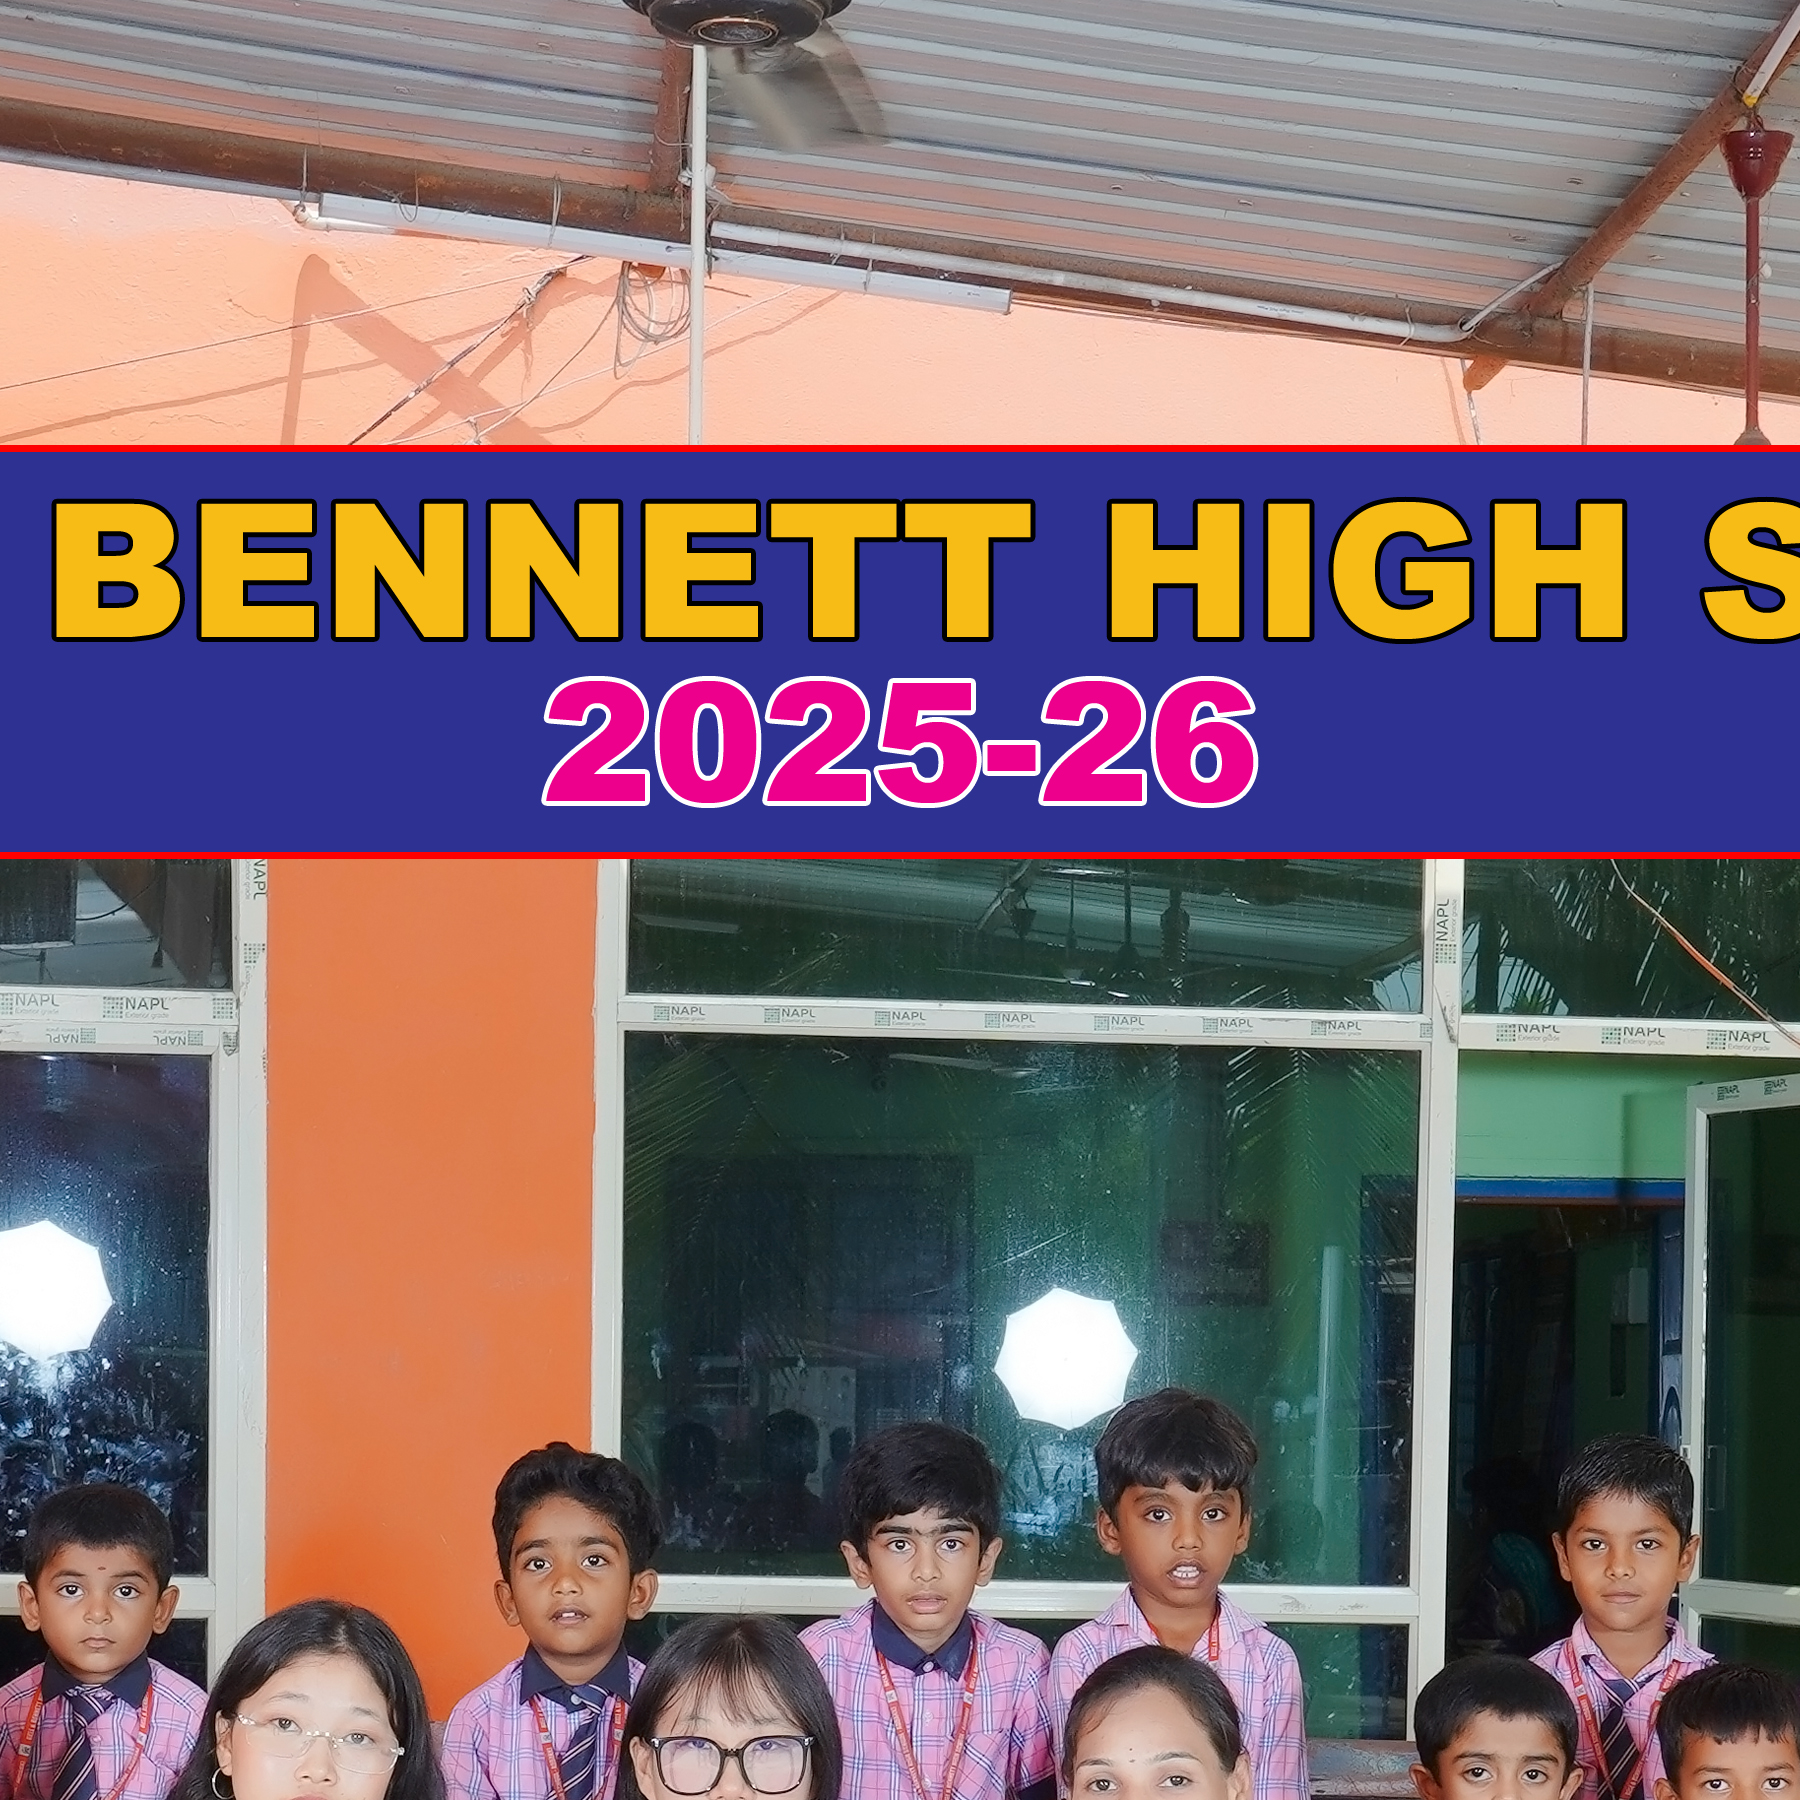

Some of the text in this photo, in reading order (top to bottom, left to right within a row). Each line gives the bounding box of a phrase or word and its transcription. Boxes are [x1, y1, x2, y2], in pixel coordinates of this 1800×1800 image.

[1437, 898, 1450, 941] NAPL
[15, 994, 60, 1006] NAPL
[125, 997, 169, 1010] NAPL
[671, 1006, 706, 1016] NAPL
[782, 1008, 816, 1018] NAPL
[892, 1011, 927, 1021] NAPL
[1002, 1013, 1036, 1023] NAPL
[1111, 1016, 1145, 1026] NAPL
[1220, 1018, 1254, 1029] NAPL
[1328, 1020, 1363, 1031] NAPL
[46, 1034, 79, 1044] NAPL
[153, 1035, 186, 1045] NAPL
[1728, 1030, 1771, 1044] NAPL
